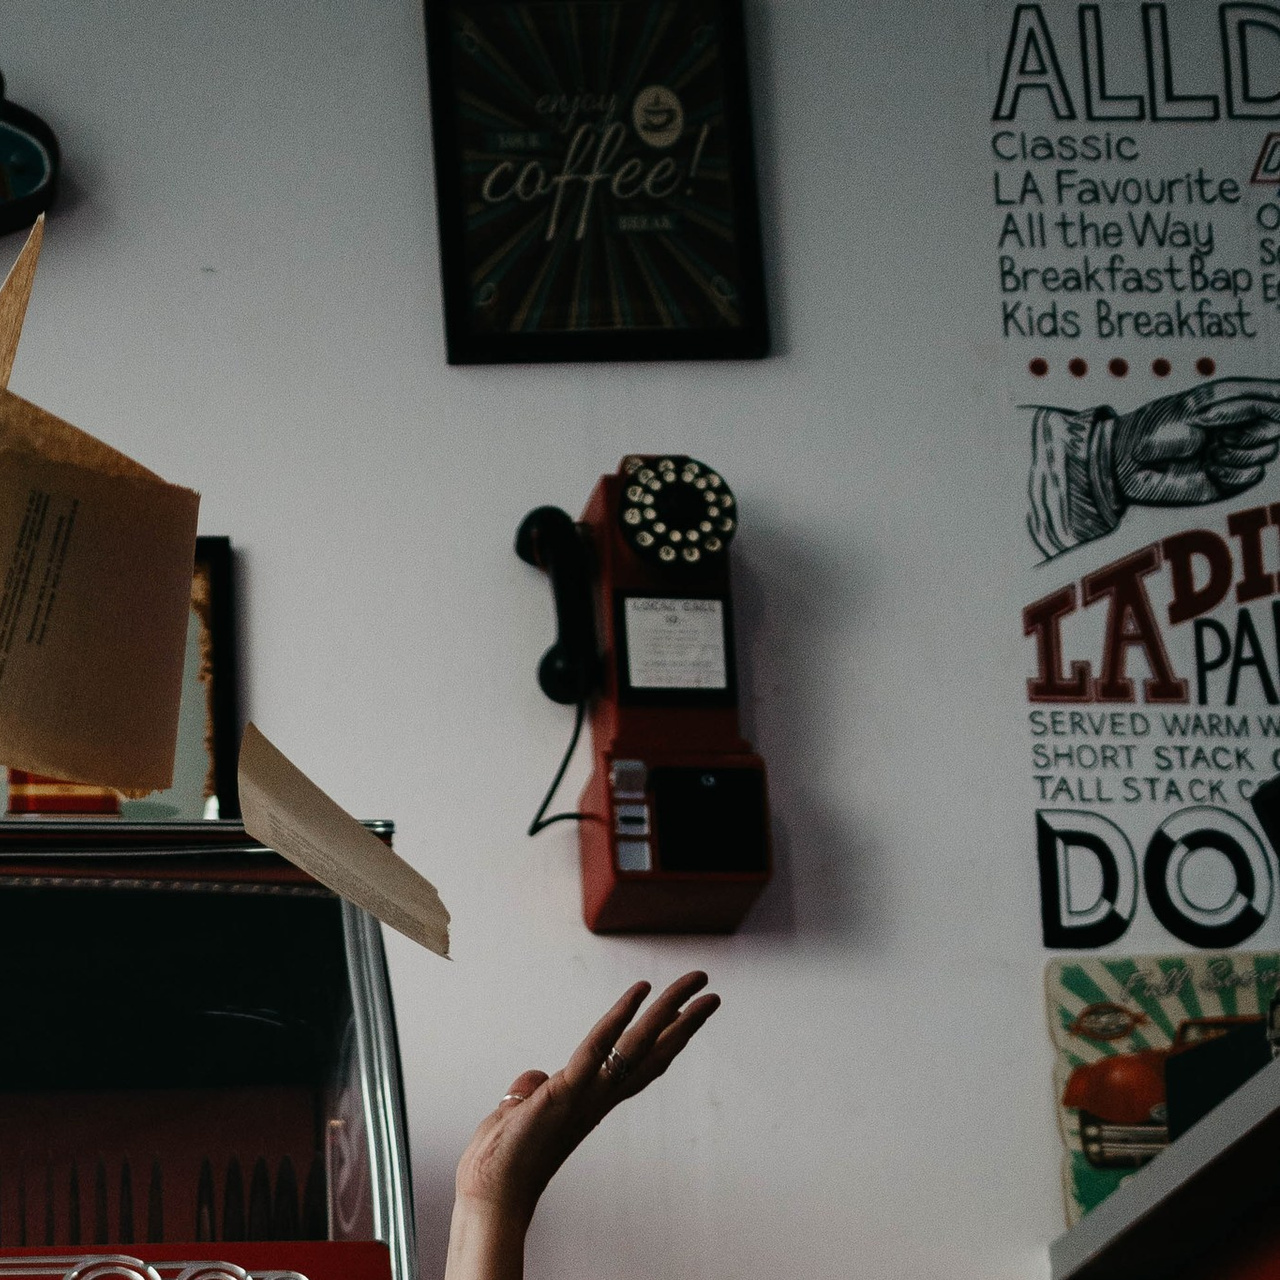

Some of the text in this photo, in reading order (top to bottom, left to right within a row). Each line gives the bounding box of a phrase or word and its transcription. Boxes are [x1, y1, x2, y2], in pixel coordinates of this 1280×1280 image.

[991, 131, 1140, 162] Classic
[480, 120, 711, 242] coffee!
[994, 168, 1242, 205] LA Favourite
[998, 211, 1215, 257] All the Way
[999, 255, 1185, 294] Breakfast
[1002, 298, 1257, 338] Kids Breakfast
[1194, 600, 1280, 706] PA
[1028, 711, 1151, 736] SERVED
[1160, 712, 1251, 737] WARM
[1032, 744, 1137, 770] SHORT
[1154, 746, 1256, 771] STACK
[1033, 775, 1113, 802] TALL
[1122, 777, 1228, 803] STACK
